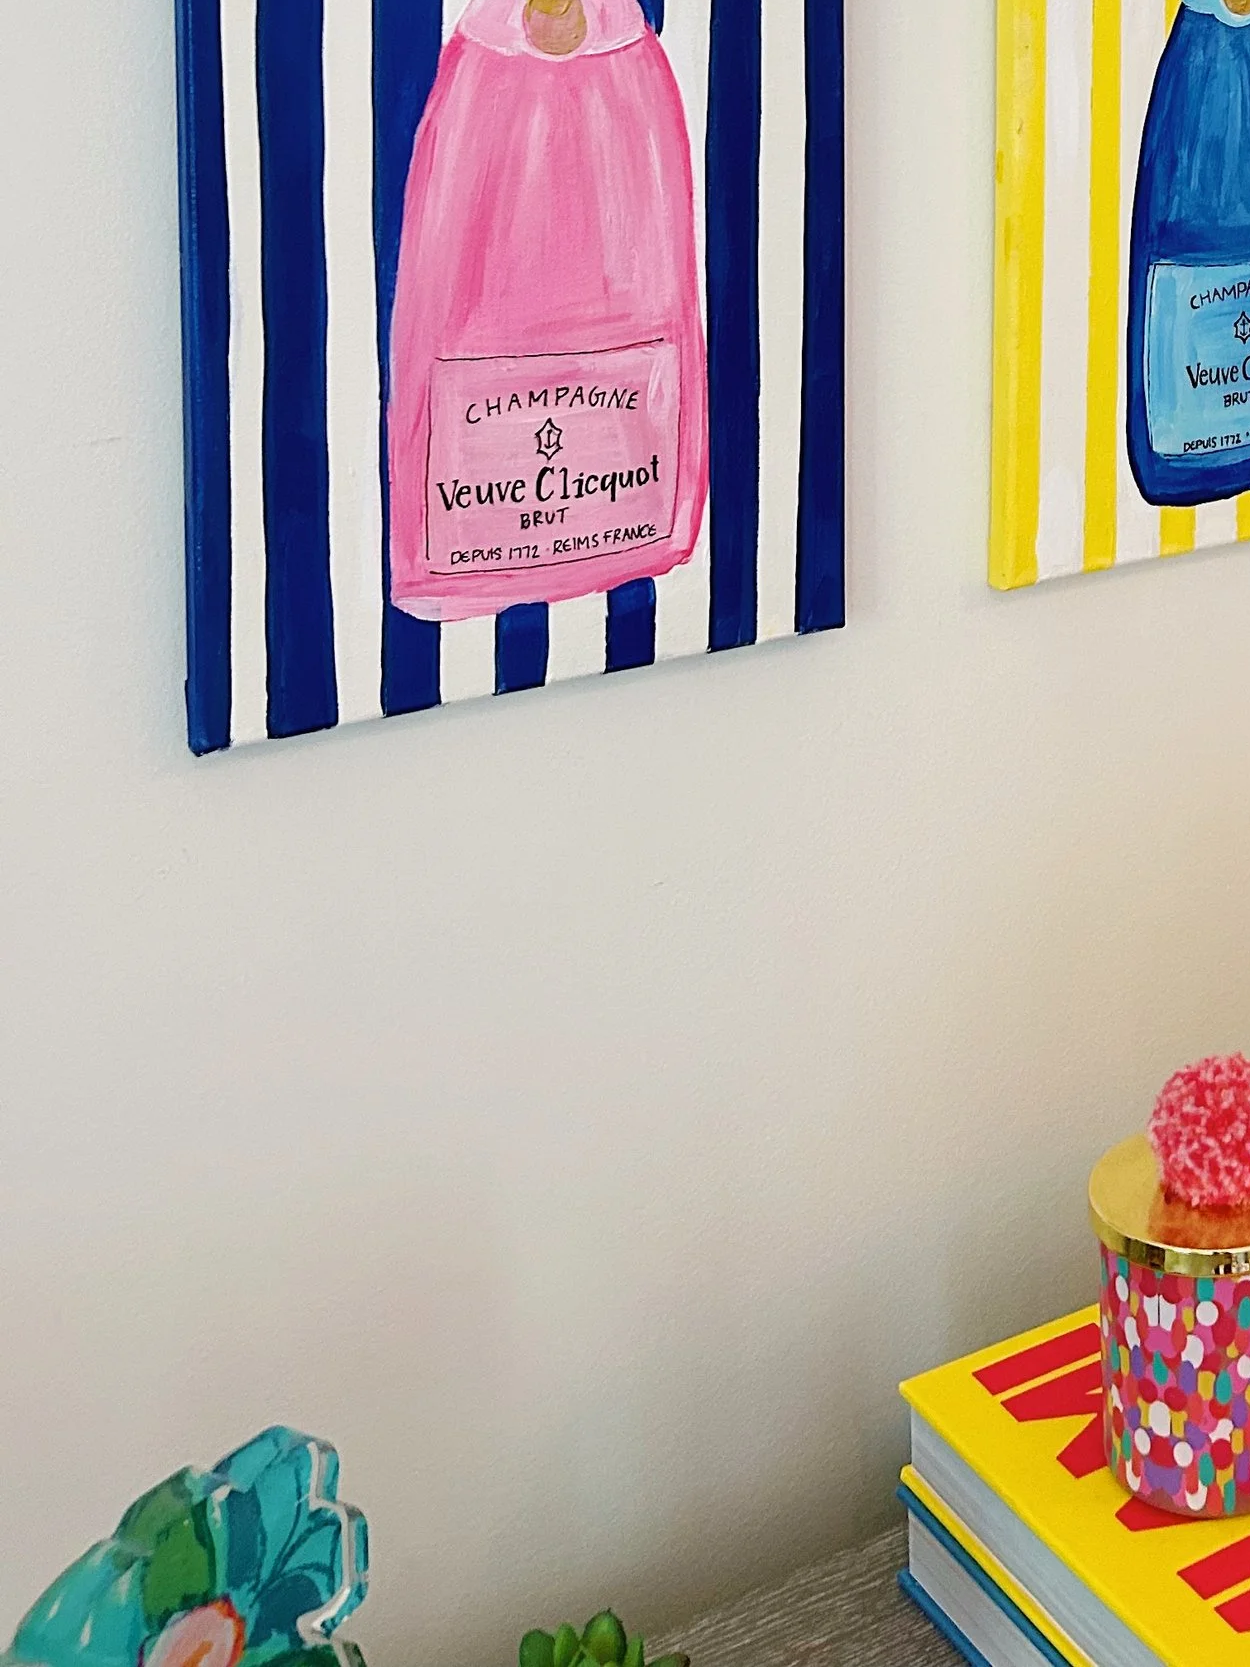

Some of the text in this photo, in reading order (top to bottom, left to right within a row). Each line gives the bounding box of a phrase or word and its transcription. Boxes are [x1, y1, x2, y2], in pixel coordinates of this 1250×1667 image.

[1186, 362, 1239, 389] Veuve
[465, 385, 640, 424] CHAMPAGNE
[1184, 436, 1217, 452] DEPUIS
[1220, 432, 1242, 447] 1772
[436, 454, 660, 511] Veuve Clicquot
[520, 507, 569, 530] BRUT
[450, 523, 657, 565] DEPUIS 1772 REIMS FRANCE
